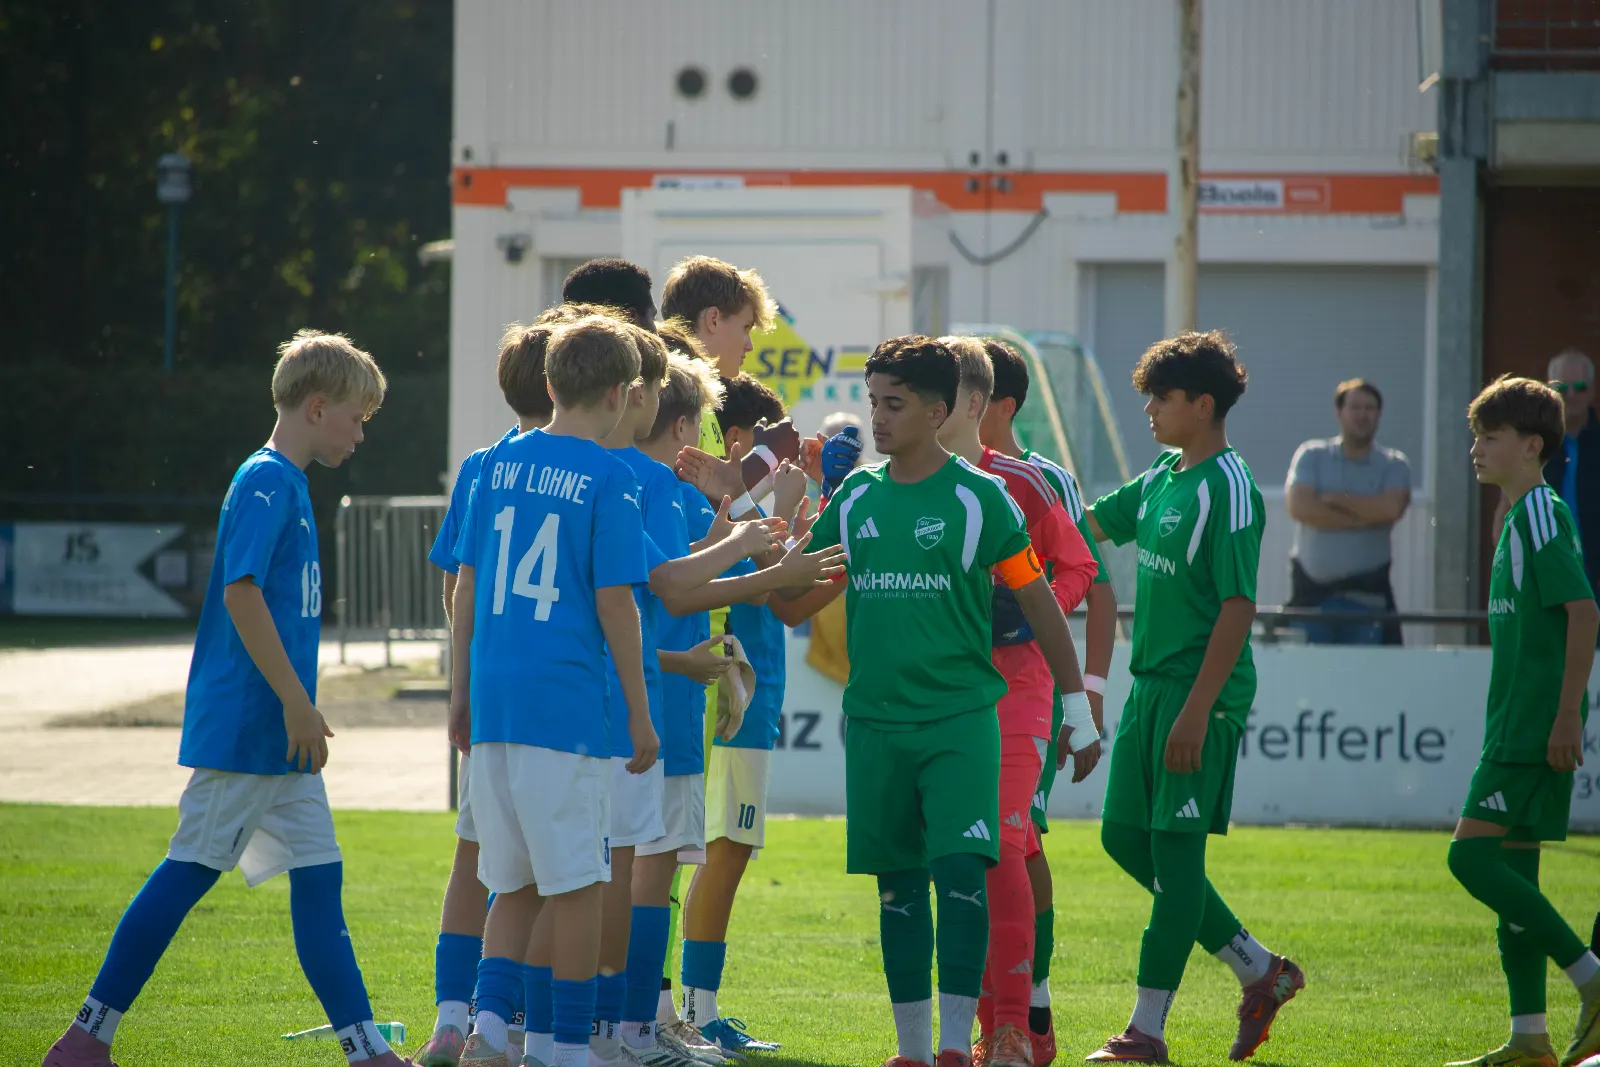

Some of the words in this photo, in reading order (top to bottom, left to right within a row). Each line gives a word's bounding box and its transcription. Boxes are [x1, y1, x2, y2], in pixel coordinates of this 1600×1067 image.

[491, 461, 523, 490] BW
[525, 463, 592, 505] LOHNE
[492, 505, 560, 622] 14
[851, 568, 951, 591] WÖHRMANN
[301, 560, 322, 618] 18
[737, 802, 756, 830] 10
